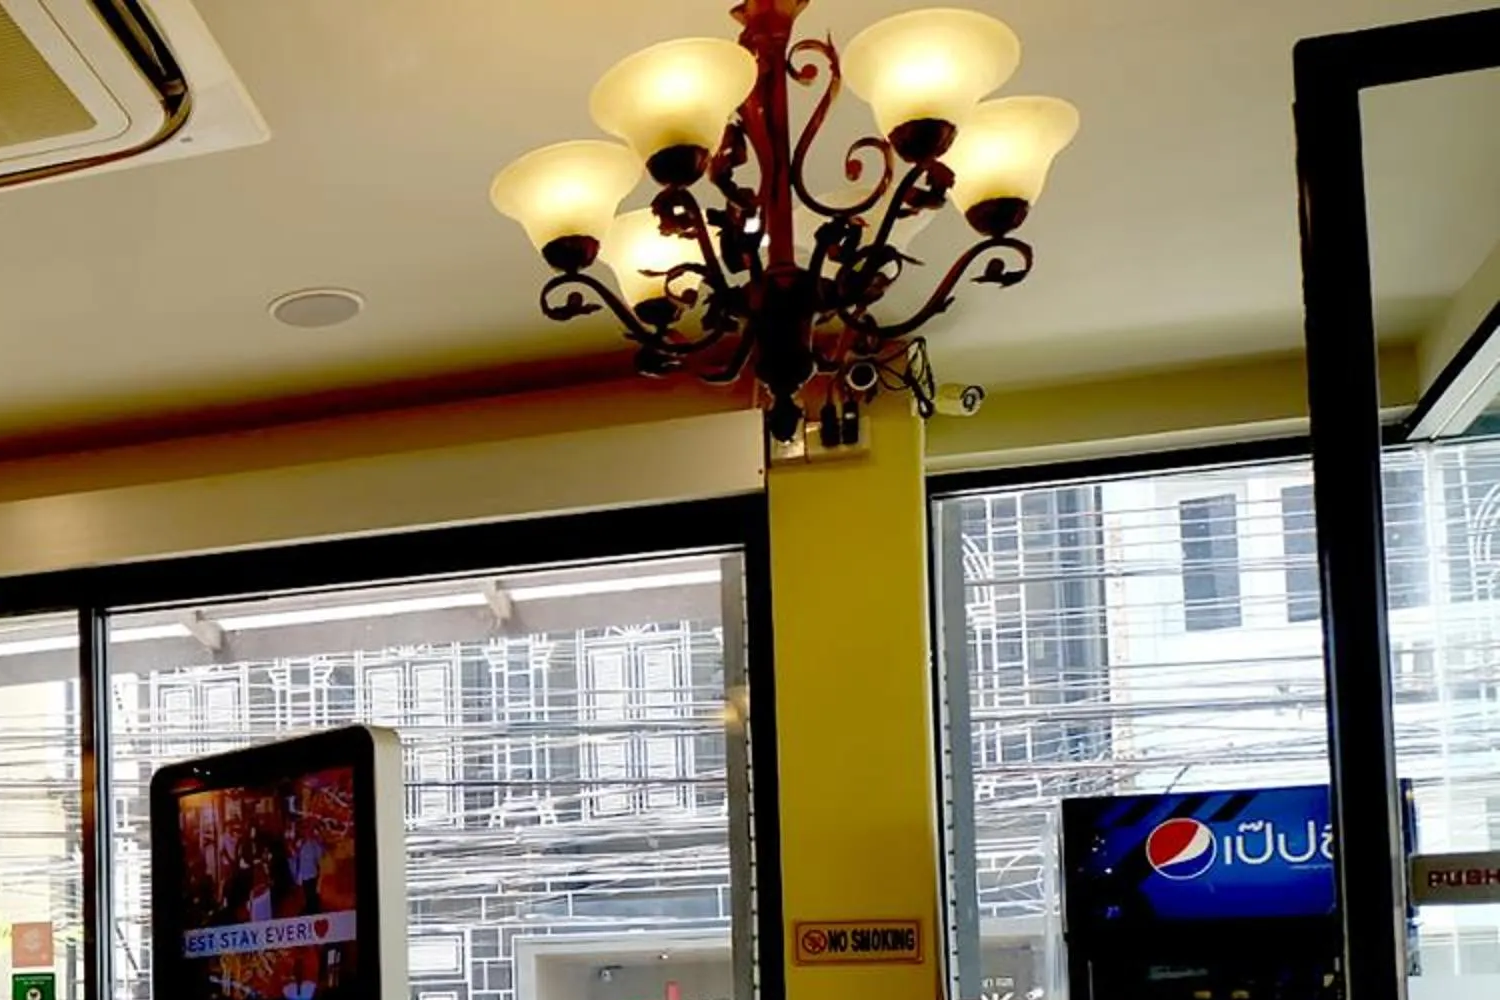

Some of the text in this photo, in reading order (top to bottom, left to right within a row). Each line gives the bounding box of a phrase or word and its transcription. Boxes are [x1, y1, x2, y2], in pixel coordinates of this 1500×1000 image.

[220, 930, 258, 949] STAY
[828, 928, 916, 952] NO SMOKING
